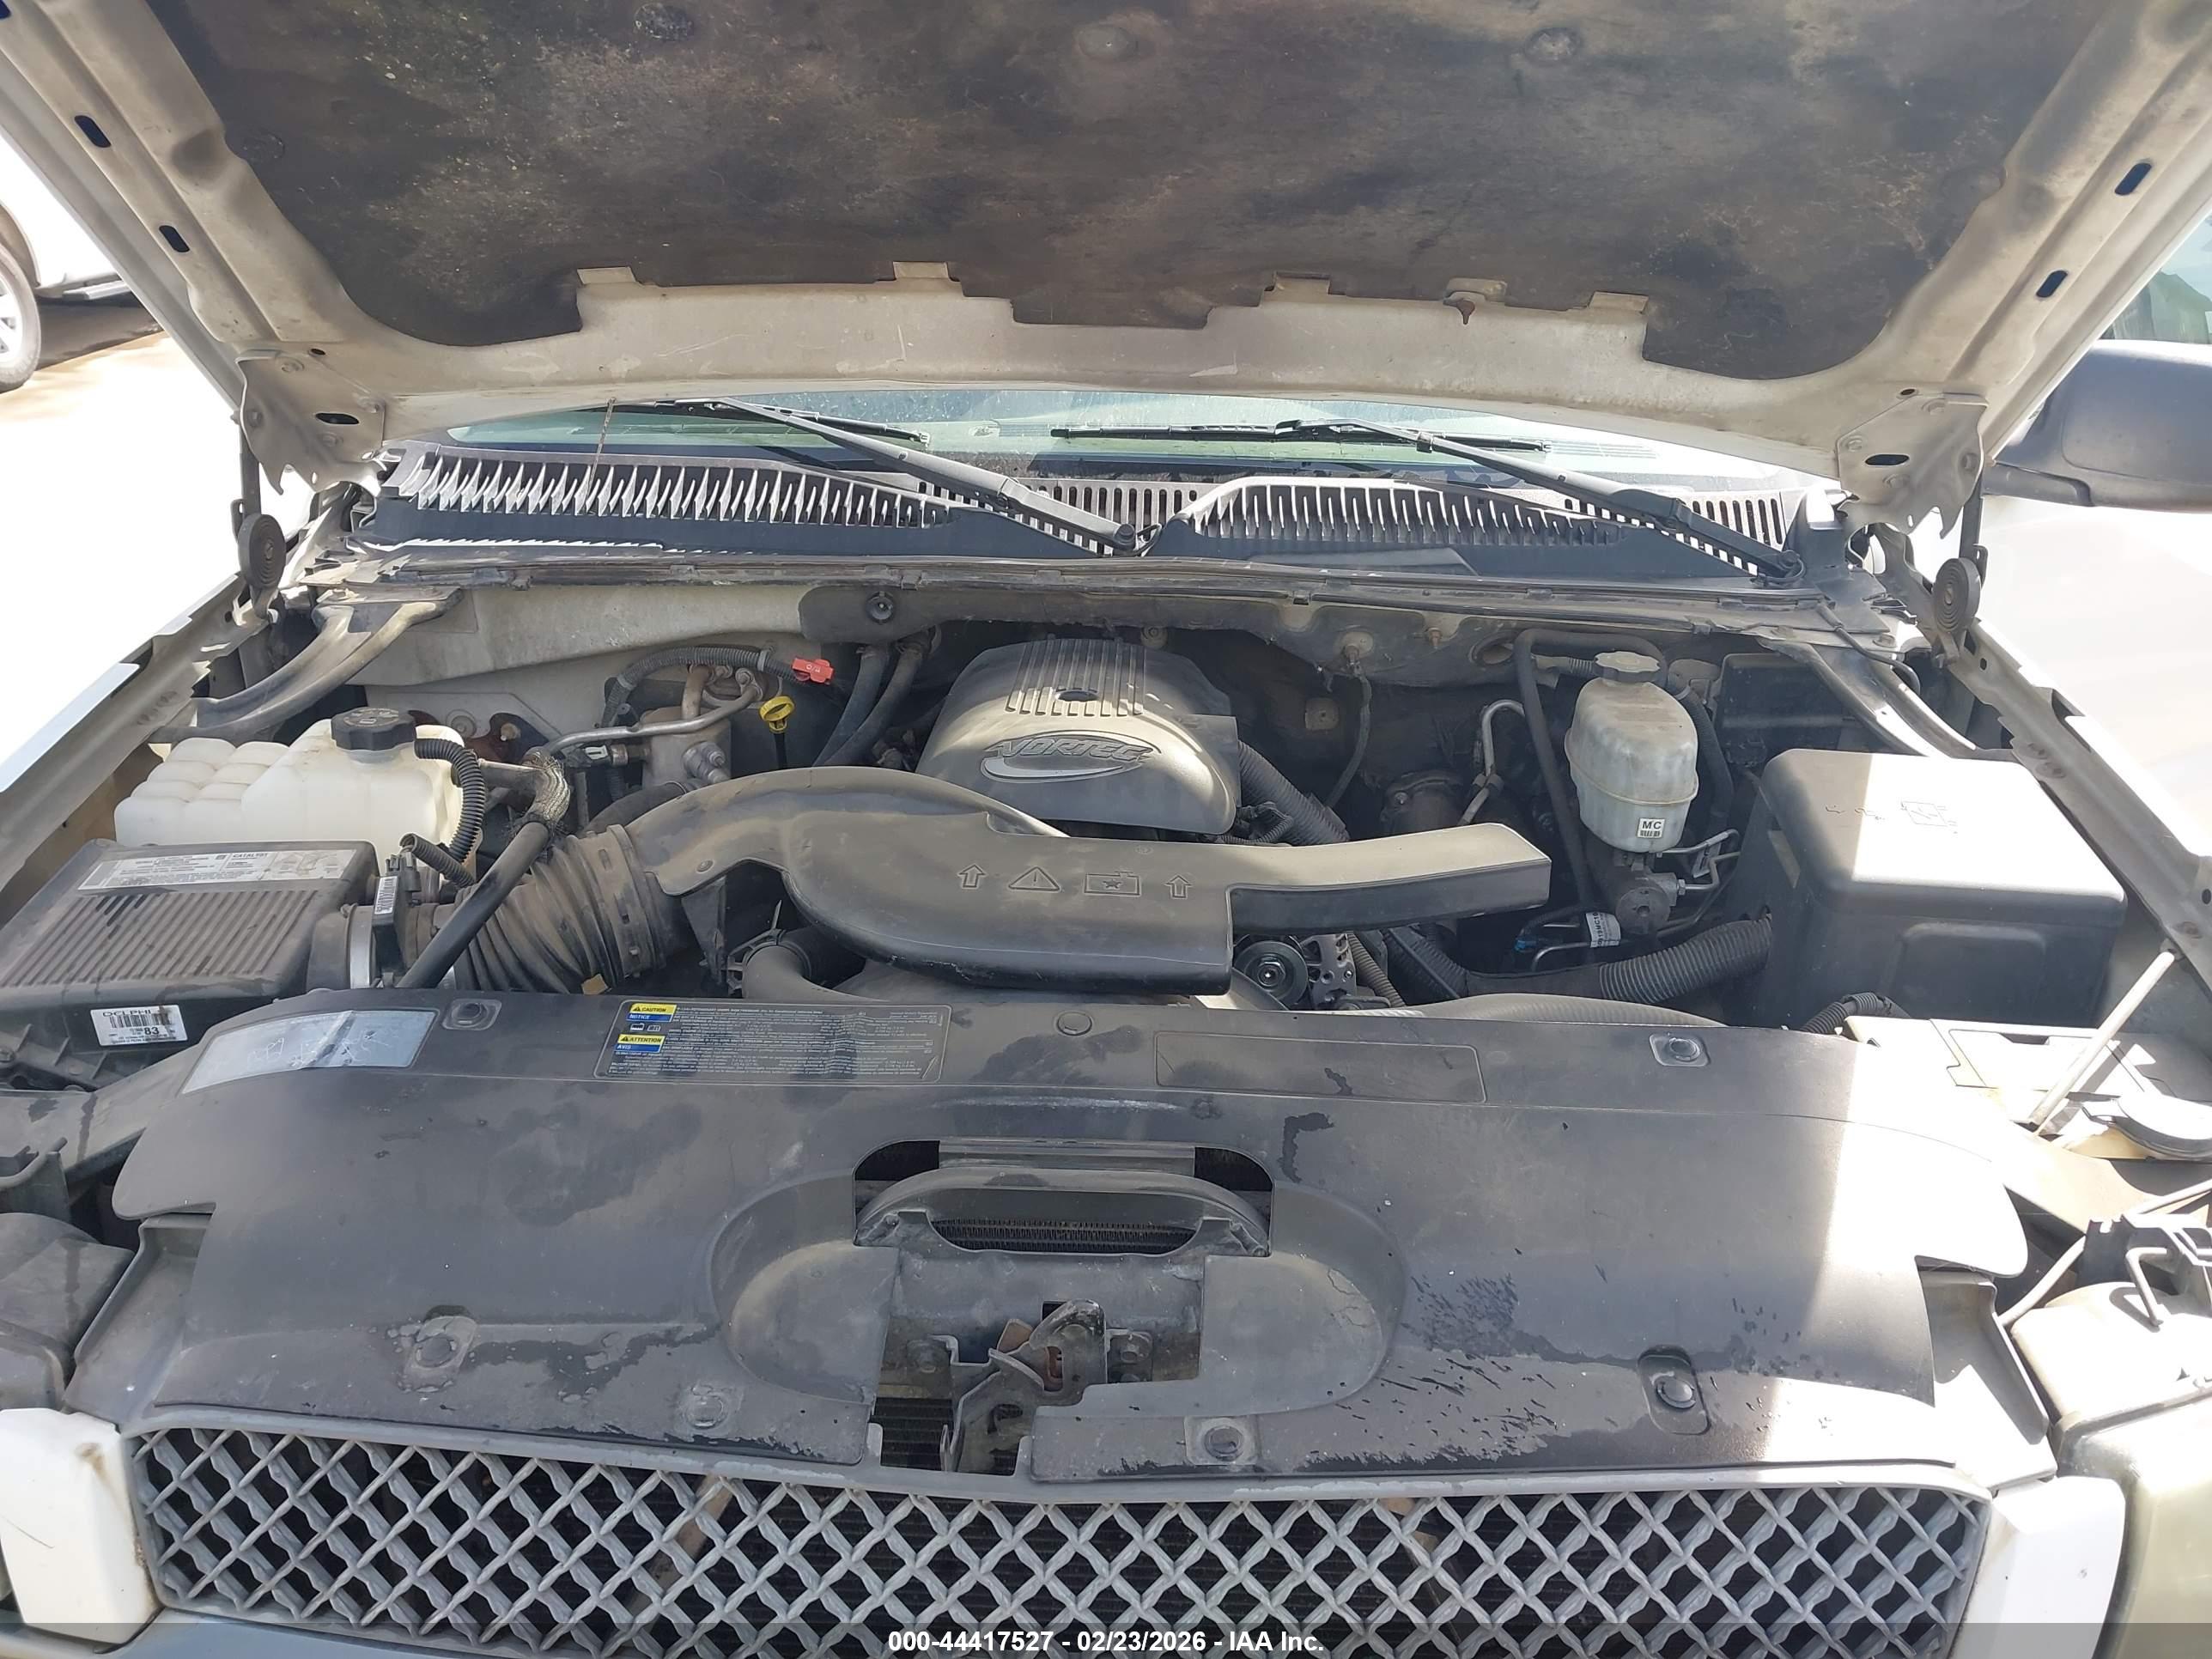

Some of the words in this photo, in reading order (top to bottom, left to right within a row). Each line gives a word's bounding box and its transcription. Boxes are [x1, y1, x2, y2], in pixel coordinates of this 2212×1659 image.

[985, 738, 1152, 762] VORTEC
[1642, 821, 1662, 830] MC
[144, 1026, 160, 1036] 83
